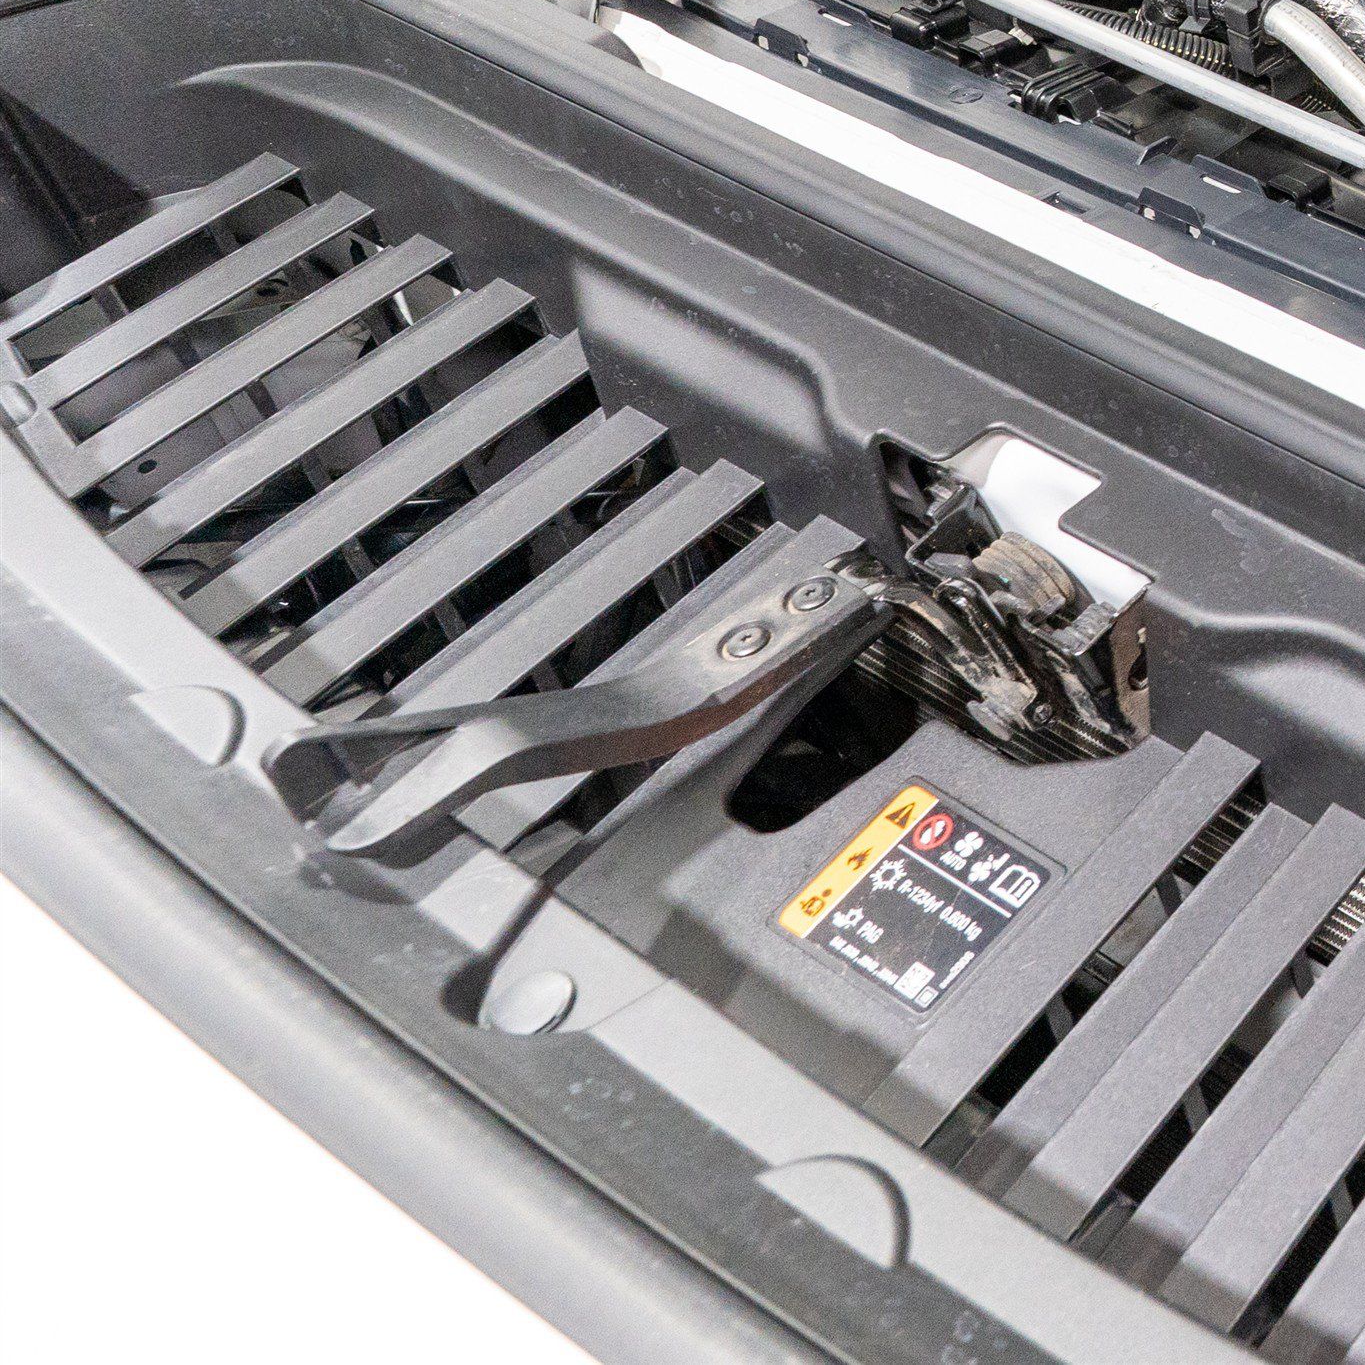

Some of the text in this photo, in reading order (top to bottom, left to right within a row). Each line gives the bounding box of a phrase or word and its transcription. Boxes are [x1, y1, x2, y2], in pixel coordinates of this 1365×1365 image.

[939, 850, 967, 871] AUTO
[897, 879, 944, 913] R-1234yf
[963, 921, 983, 942] kg
[856, 920, 884, 944] PAG
